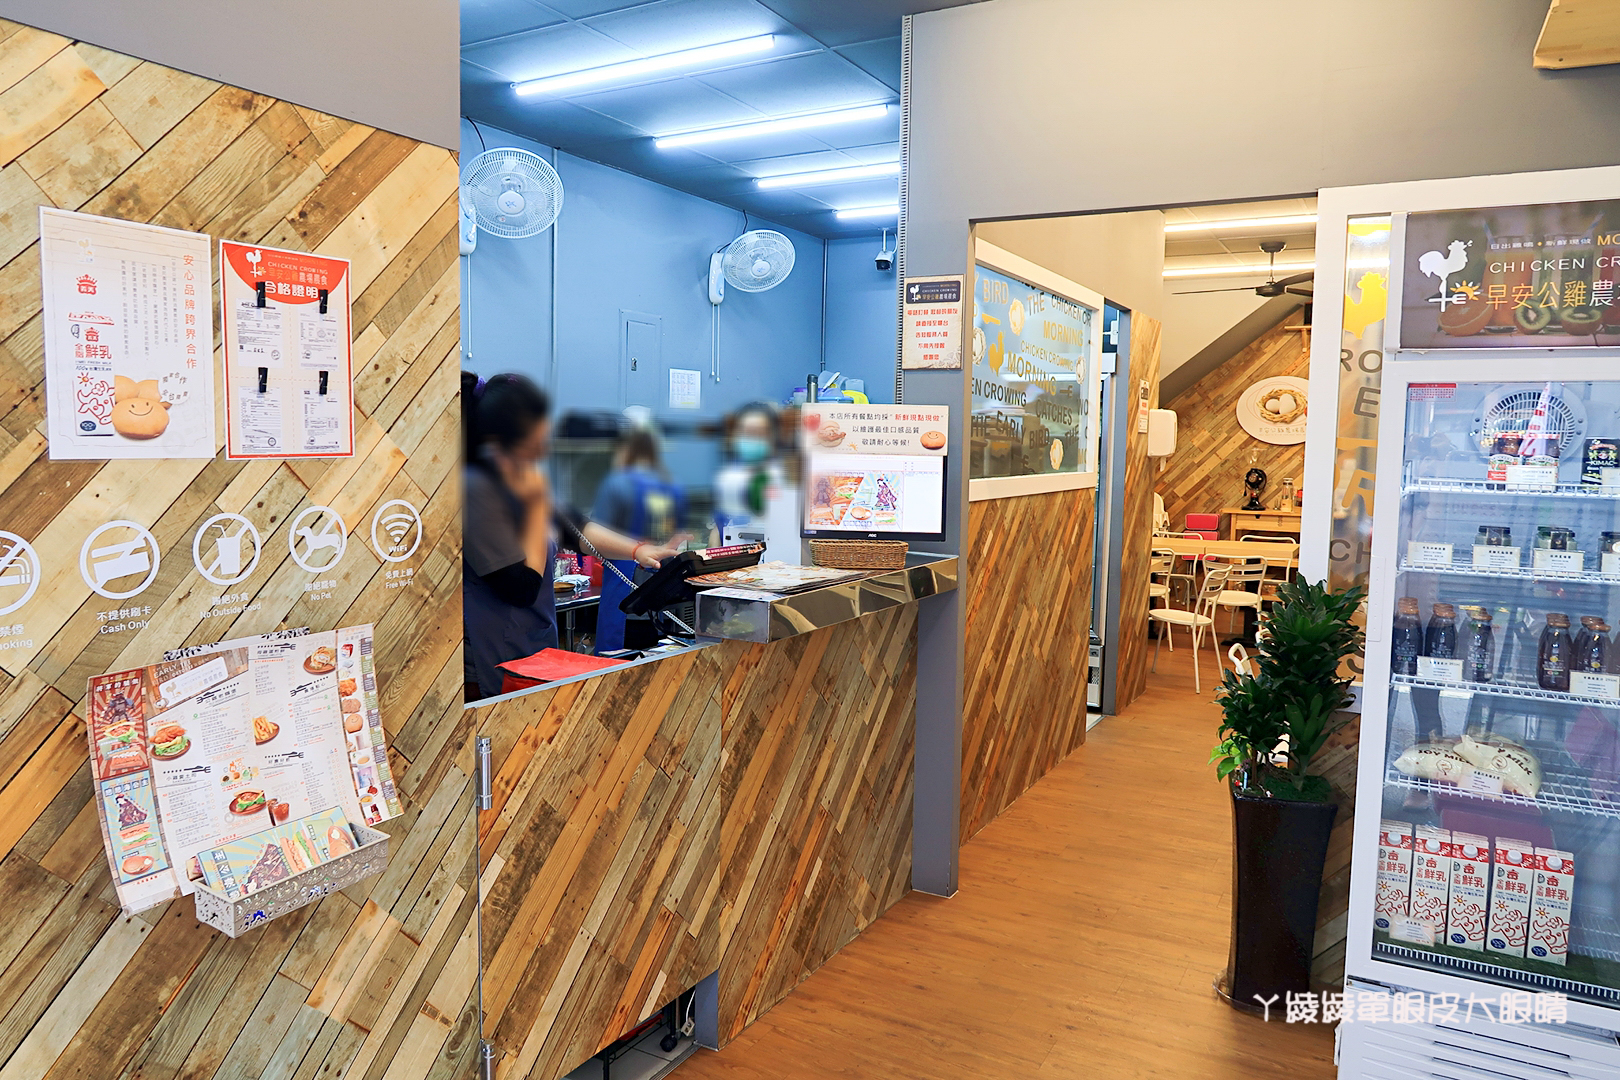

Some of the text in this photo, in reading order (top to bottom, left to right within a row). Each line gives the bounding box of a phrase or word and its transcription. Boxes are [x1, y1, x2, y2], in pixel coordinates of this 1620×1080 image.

[267, 261, 329, 275] CHICKEN CROWING
[1489, 257, 1586, 274] CHICKEN
[265, 281, 319, 299] 合格證明
[982, 278, 1009, 304] BIRD
[1485, 279, 1620, 310] 早安公雞農
[183, 254, 197, 369] 安心品牌跨界合作
[1026, 291, 1046, 317] THE
[1051, 294, 1082, 322] CHICKEN
[1043, 320, 1084, 347] MORNING
[1020, 340, 1049, 361] CHICKEN
[1007, 350, 1057, 396] MORNING
[983, 381, 1027, 407] CROWING
[1035, 399, 1073, 426] CATCHES
[852, 425, 920, 434] 以維護最佳口感品質
[388, 544, 408, 552] WiFi
[211, 592, 249, 605] 謝絕外食
[321, 592, 332, 600] Pet
[96, 605, 152, 622] 不提供刷卡
[200, 602, 262, 620] No Outside Food
[100, 619, 150, 635] Cash Only
[1386, 861, 1408, 875] 鮮乳
[1424, 868, 1447, 882] 鮮乳
[1462, 874, 1485, 889] 鮮乳
[1504, 880, 1529, 894] 鮮乳
[1545, 887, 1570, 901] 鮮乳
